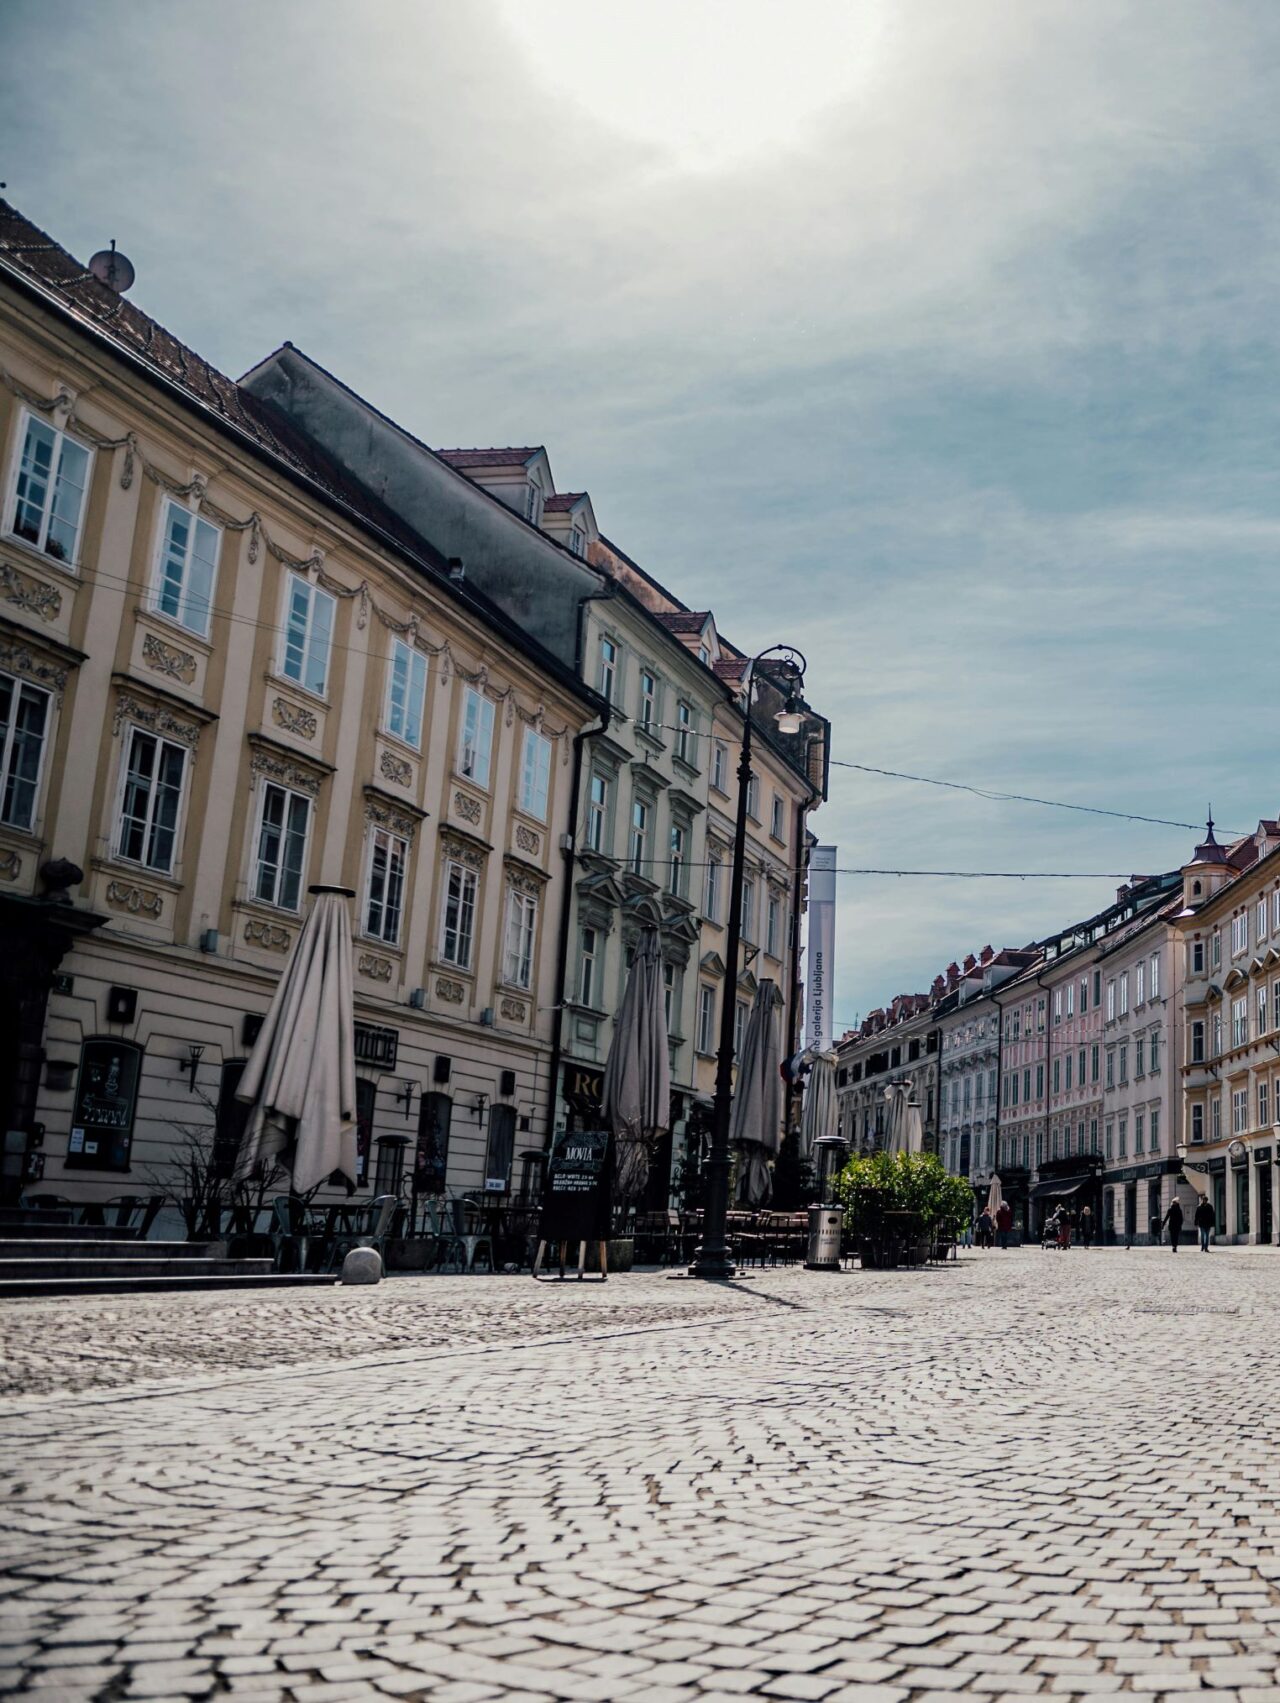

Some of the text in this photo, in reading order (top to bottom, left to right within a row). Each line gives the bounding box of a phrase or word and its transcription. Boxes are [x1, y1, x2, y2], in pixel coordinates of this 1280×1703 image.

[812, 952, 825, 997] Ljubljana
[811, 1000, 824, 1037] galerija
[565, 1147, 593, 1161] MOVIA
